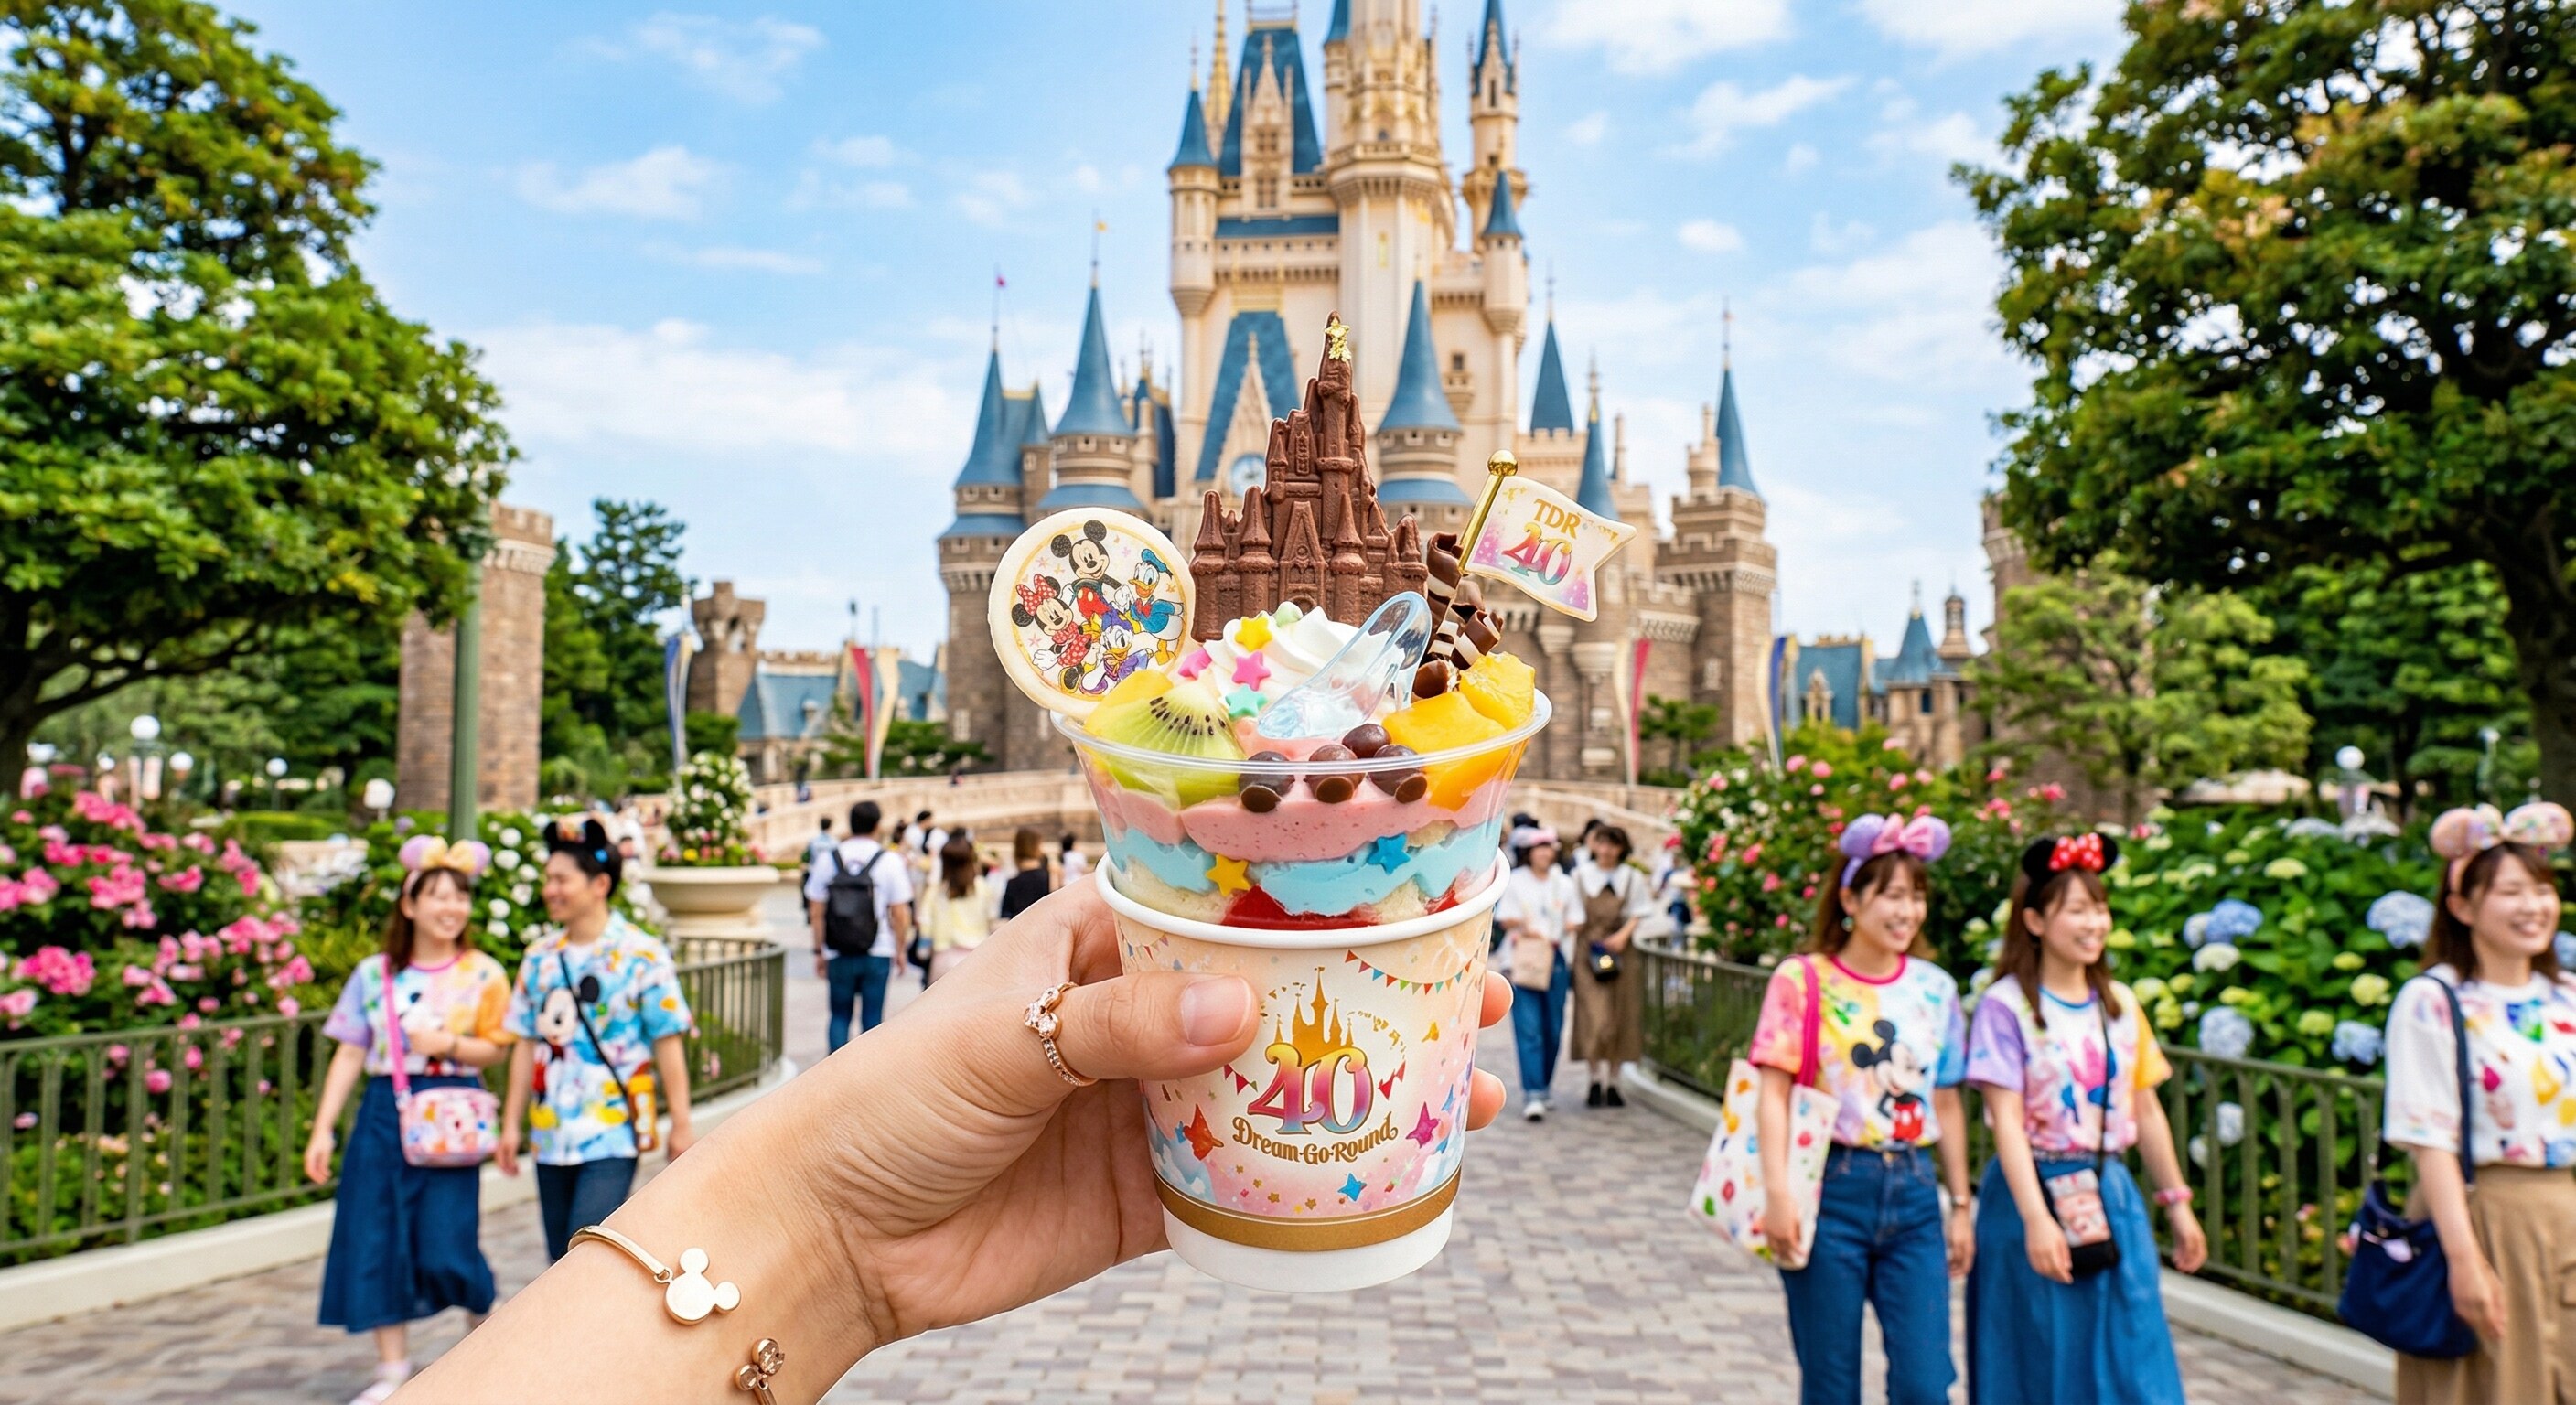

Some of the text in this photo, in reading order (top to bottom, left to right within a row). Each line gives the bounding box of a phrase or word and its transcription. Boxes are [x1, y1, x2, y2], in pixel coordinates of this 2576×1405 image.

[1533, 498, 1580, 539] TDR
[1502, 521, 1572, 585] 40
[1247, 1042, 1374, 1135] 40
